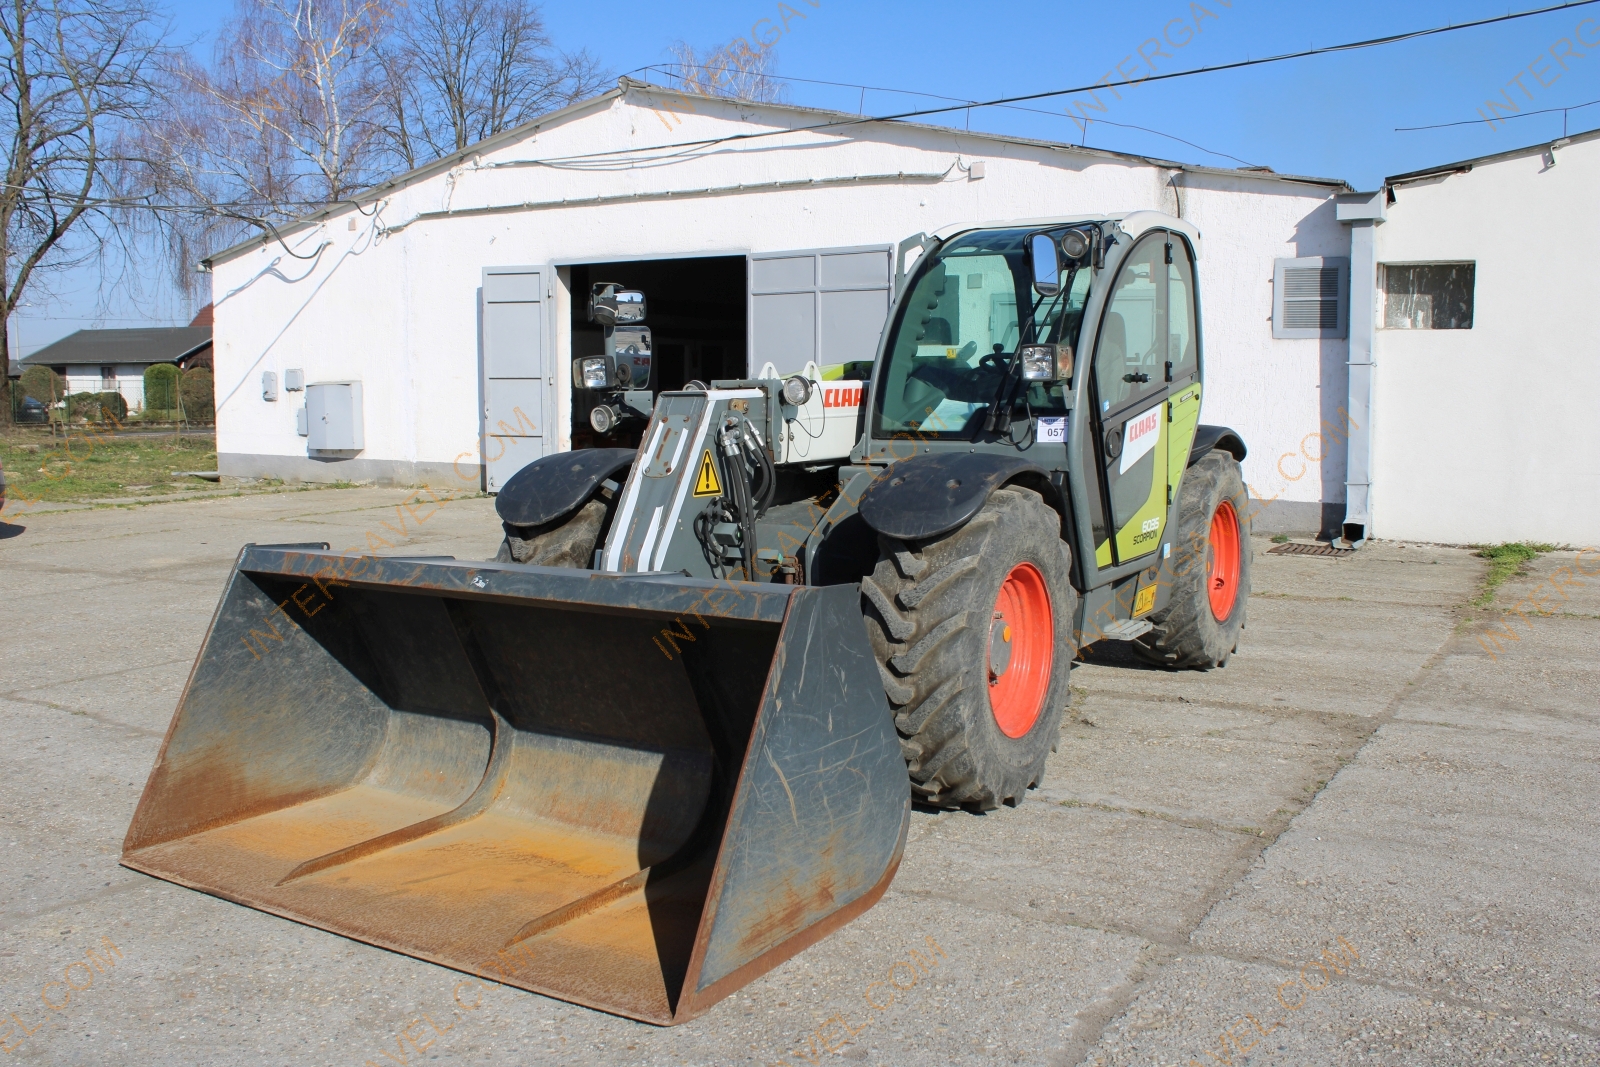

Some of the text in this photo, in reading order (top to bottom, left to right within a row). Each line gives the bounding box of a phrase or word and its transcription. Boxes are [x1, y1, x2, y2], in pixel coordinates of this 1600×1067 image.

[824, 388, 868, 407] CLAA
[1047, 428, 1064, 437] 057
[1129, 413, 1157, 443] CLAAS
[1133, 529, 1157, 545] SCORPION
